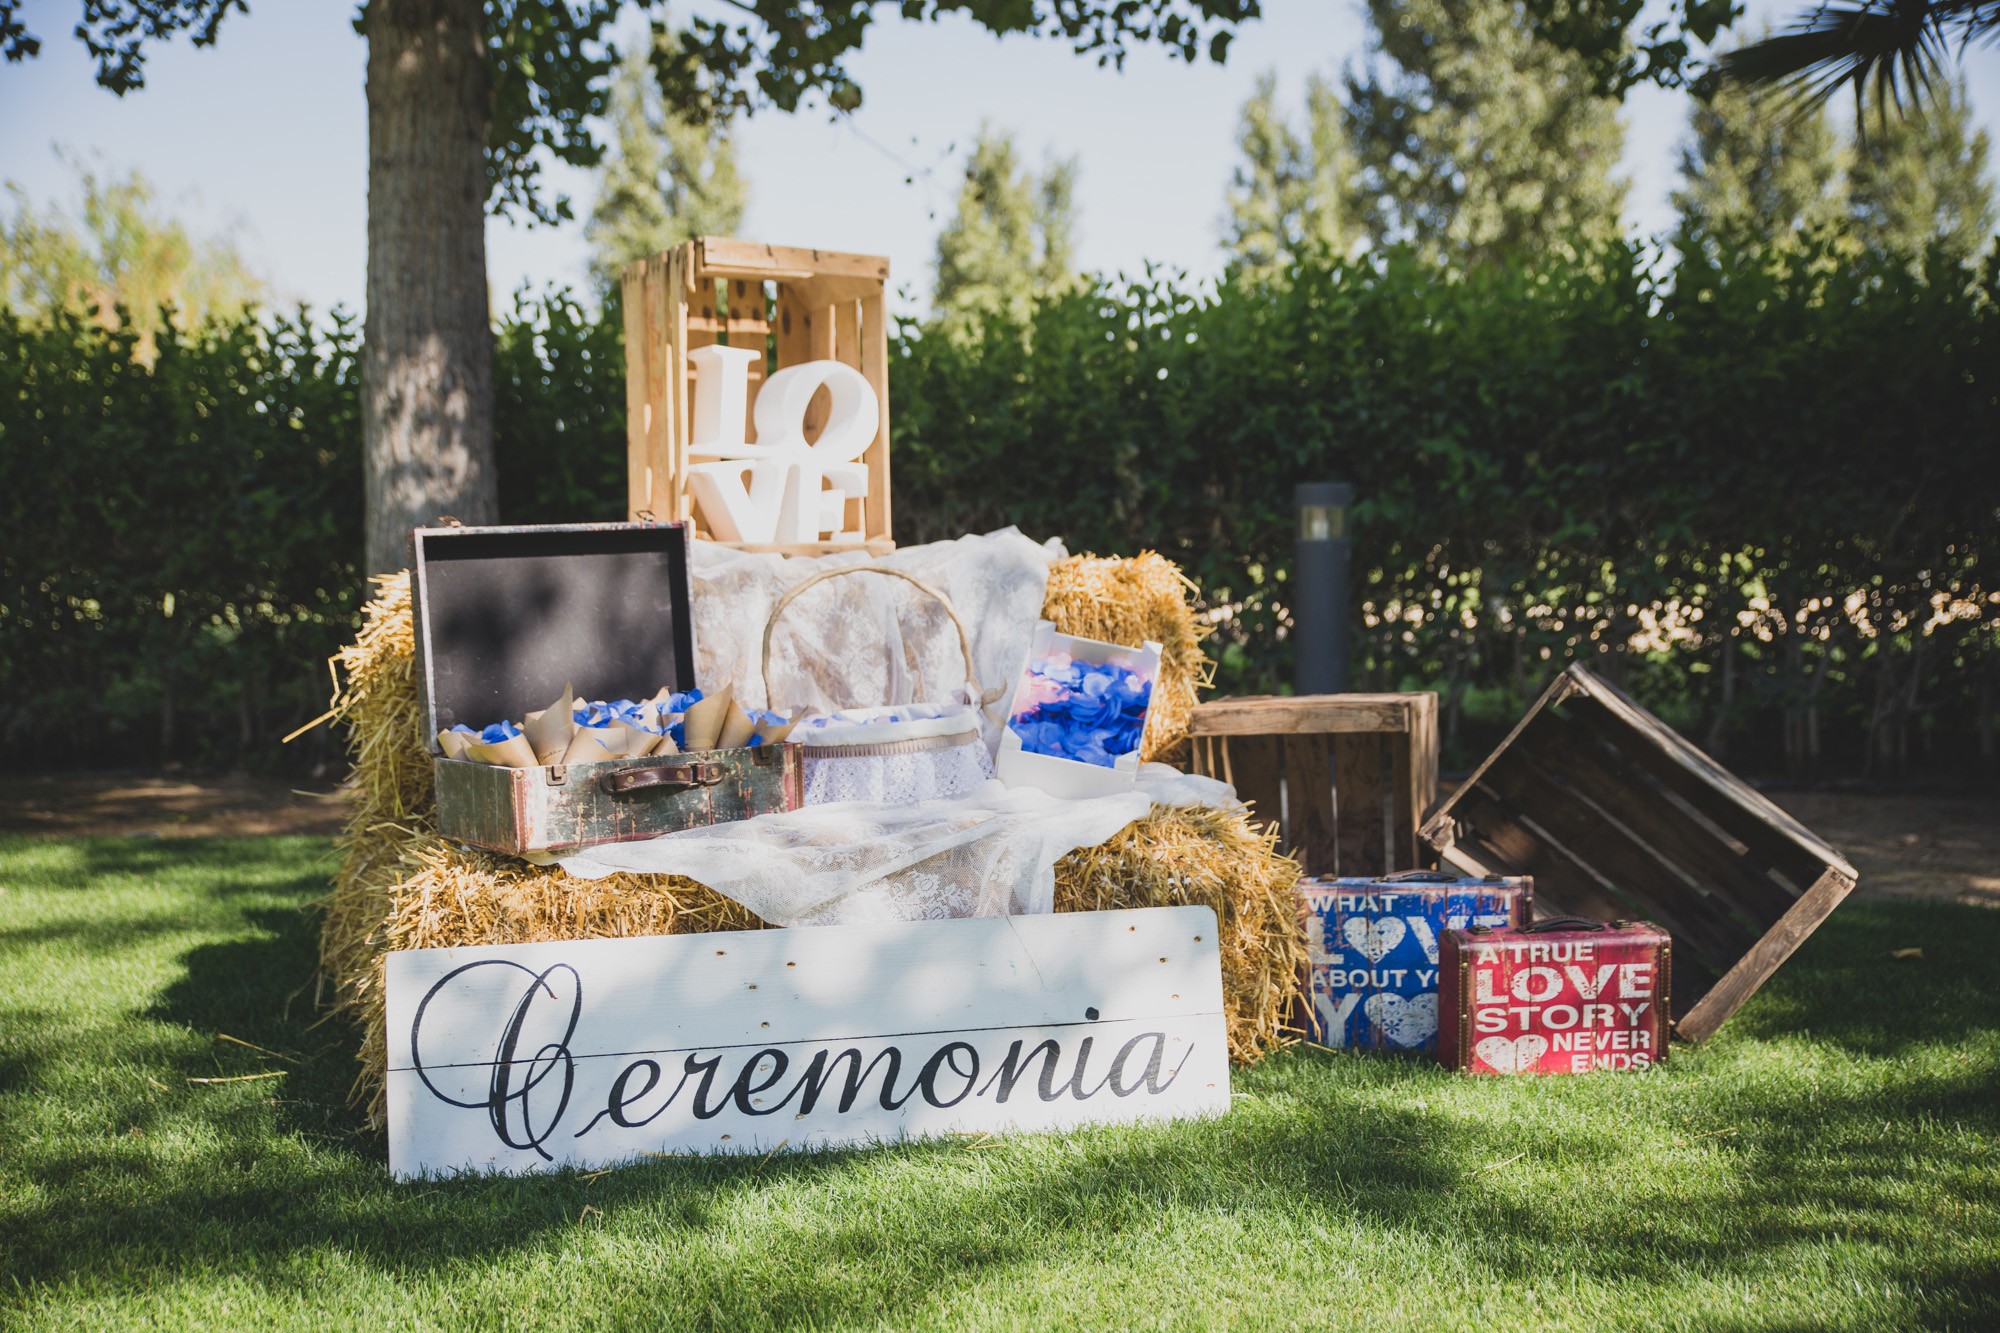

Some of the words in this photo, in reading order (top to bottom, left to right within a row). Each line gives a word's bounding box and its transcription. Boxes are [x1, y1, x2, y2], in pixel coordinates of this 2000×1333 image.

[1307, 894, 1399, 912] WHAT
[1504, 892, 1512, 911] I
[1476, 943, 1500, 966] A
[1507, 941, 1594, 965] TRUE
[1310, 968, 1409, 988] ABOUT
[1476, 963, 1653, 1004] LOVE
[1475, 1002, 1651, 1033] STORY
[1552, 1030, 1651, 1052] NEVER
[411, 958, 1195, 1162] Ceremonia
[1571, 1052, 1651, 1074] ENDS
